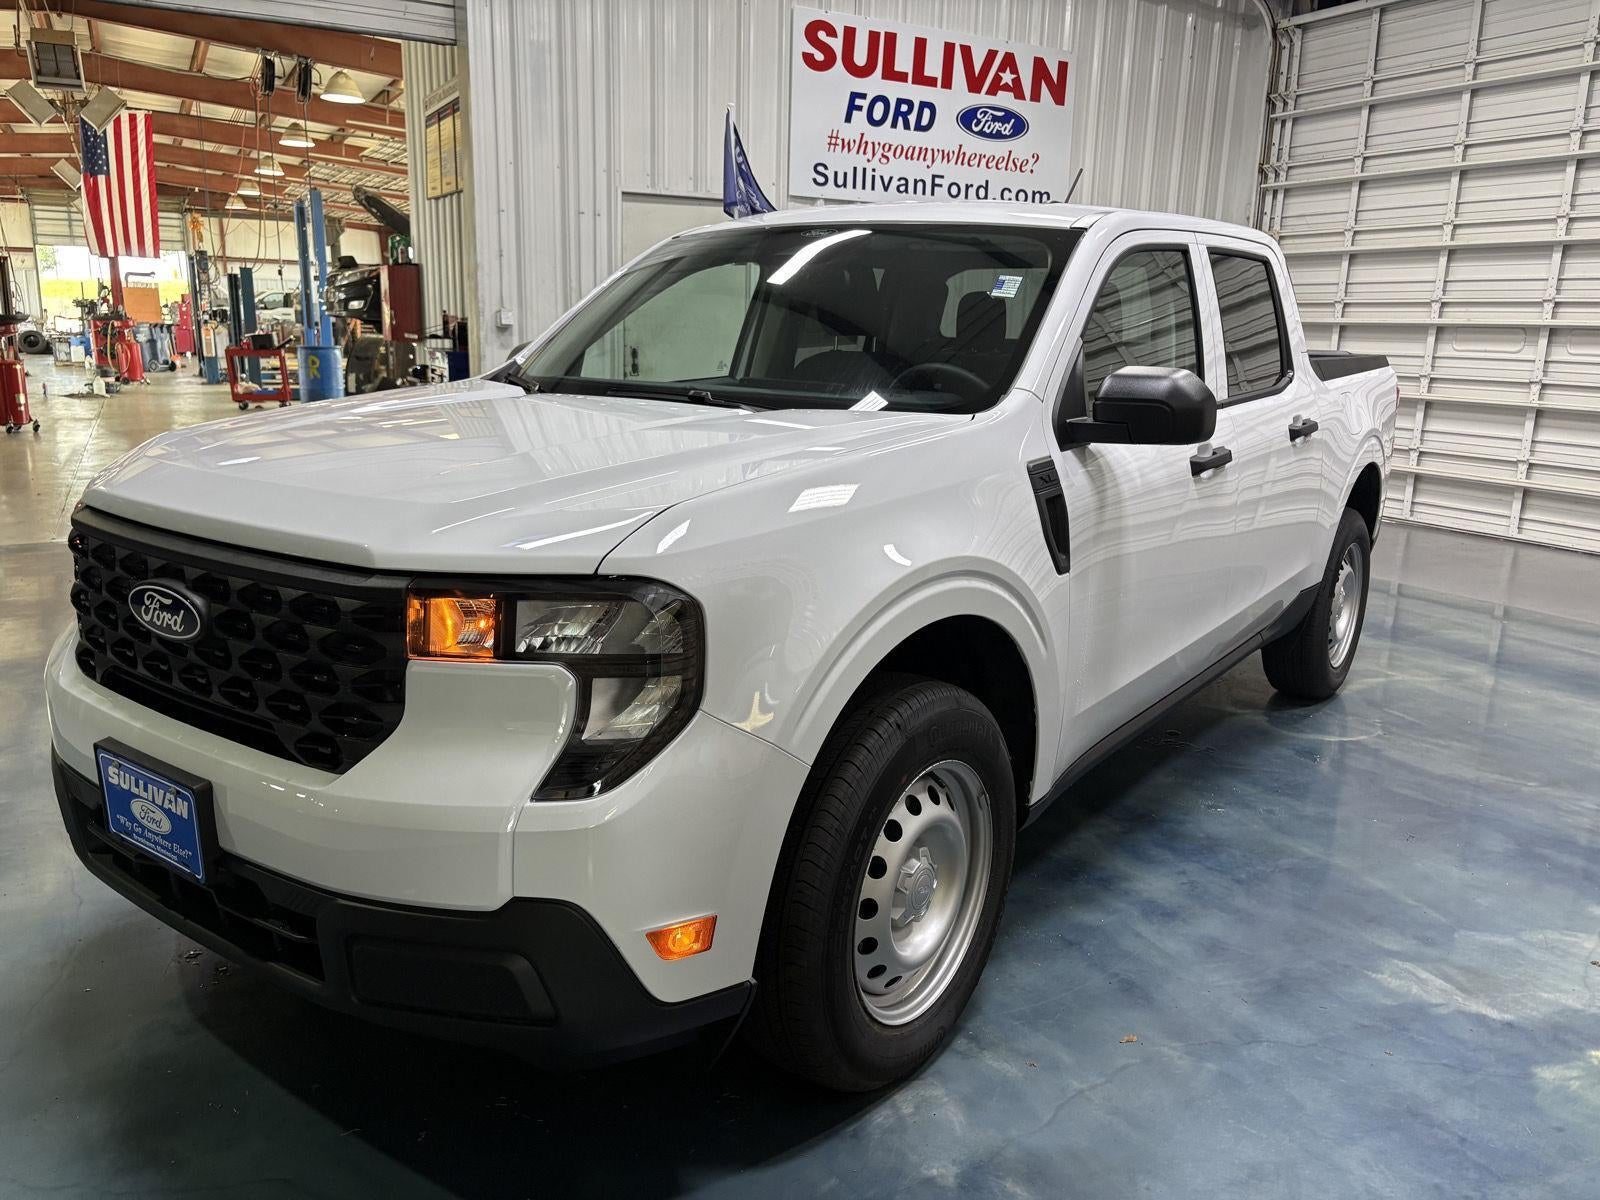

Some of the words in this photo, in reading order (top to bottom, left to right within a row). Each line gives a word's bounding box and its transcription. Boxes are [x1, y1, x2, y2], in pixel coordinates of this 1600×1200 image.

[801, 19, 1069, 107] SULLIVAN
[844, 91, 937, 133] FORD
[971, 108, 1015, 136] Ford
[827, 129, 1040, 174] #whygoanywhereelse?
[812, 162, 1052, 203] SullivanFord.com
[141, 591, 184, 632] Ford
[107, 765, 189, 820] SULLIVAN
[139, 804, 163, 830] Ford
[143, 828, 172, 850] Anywhere
